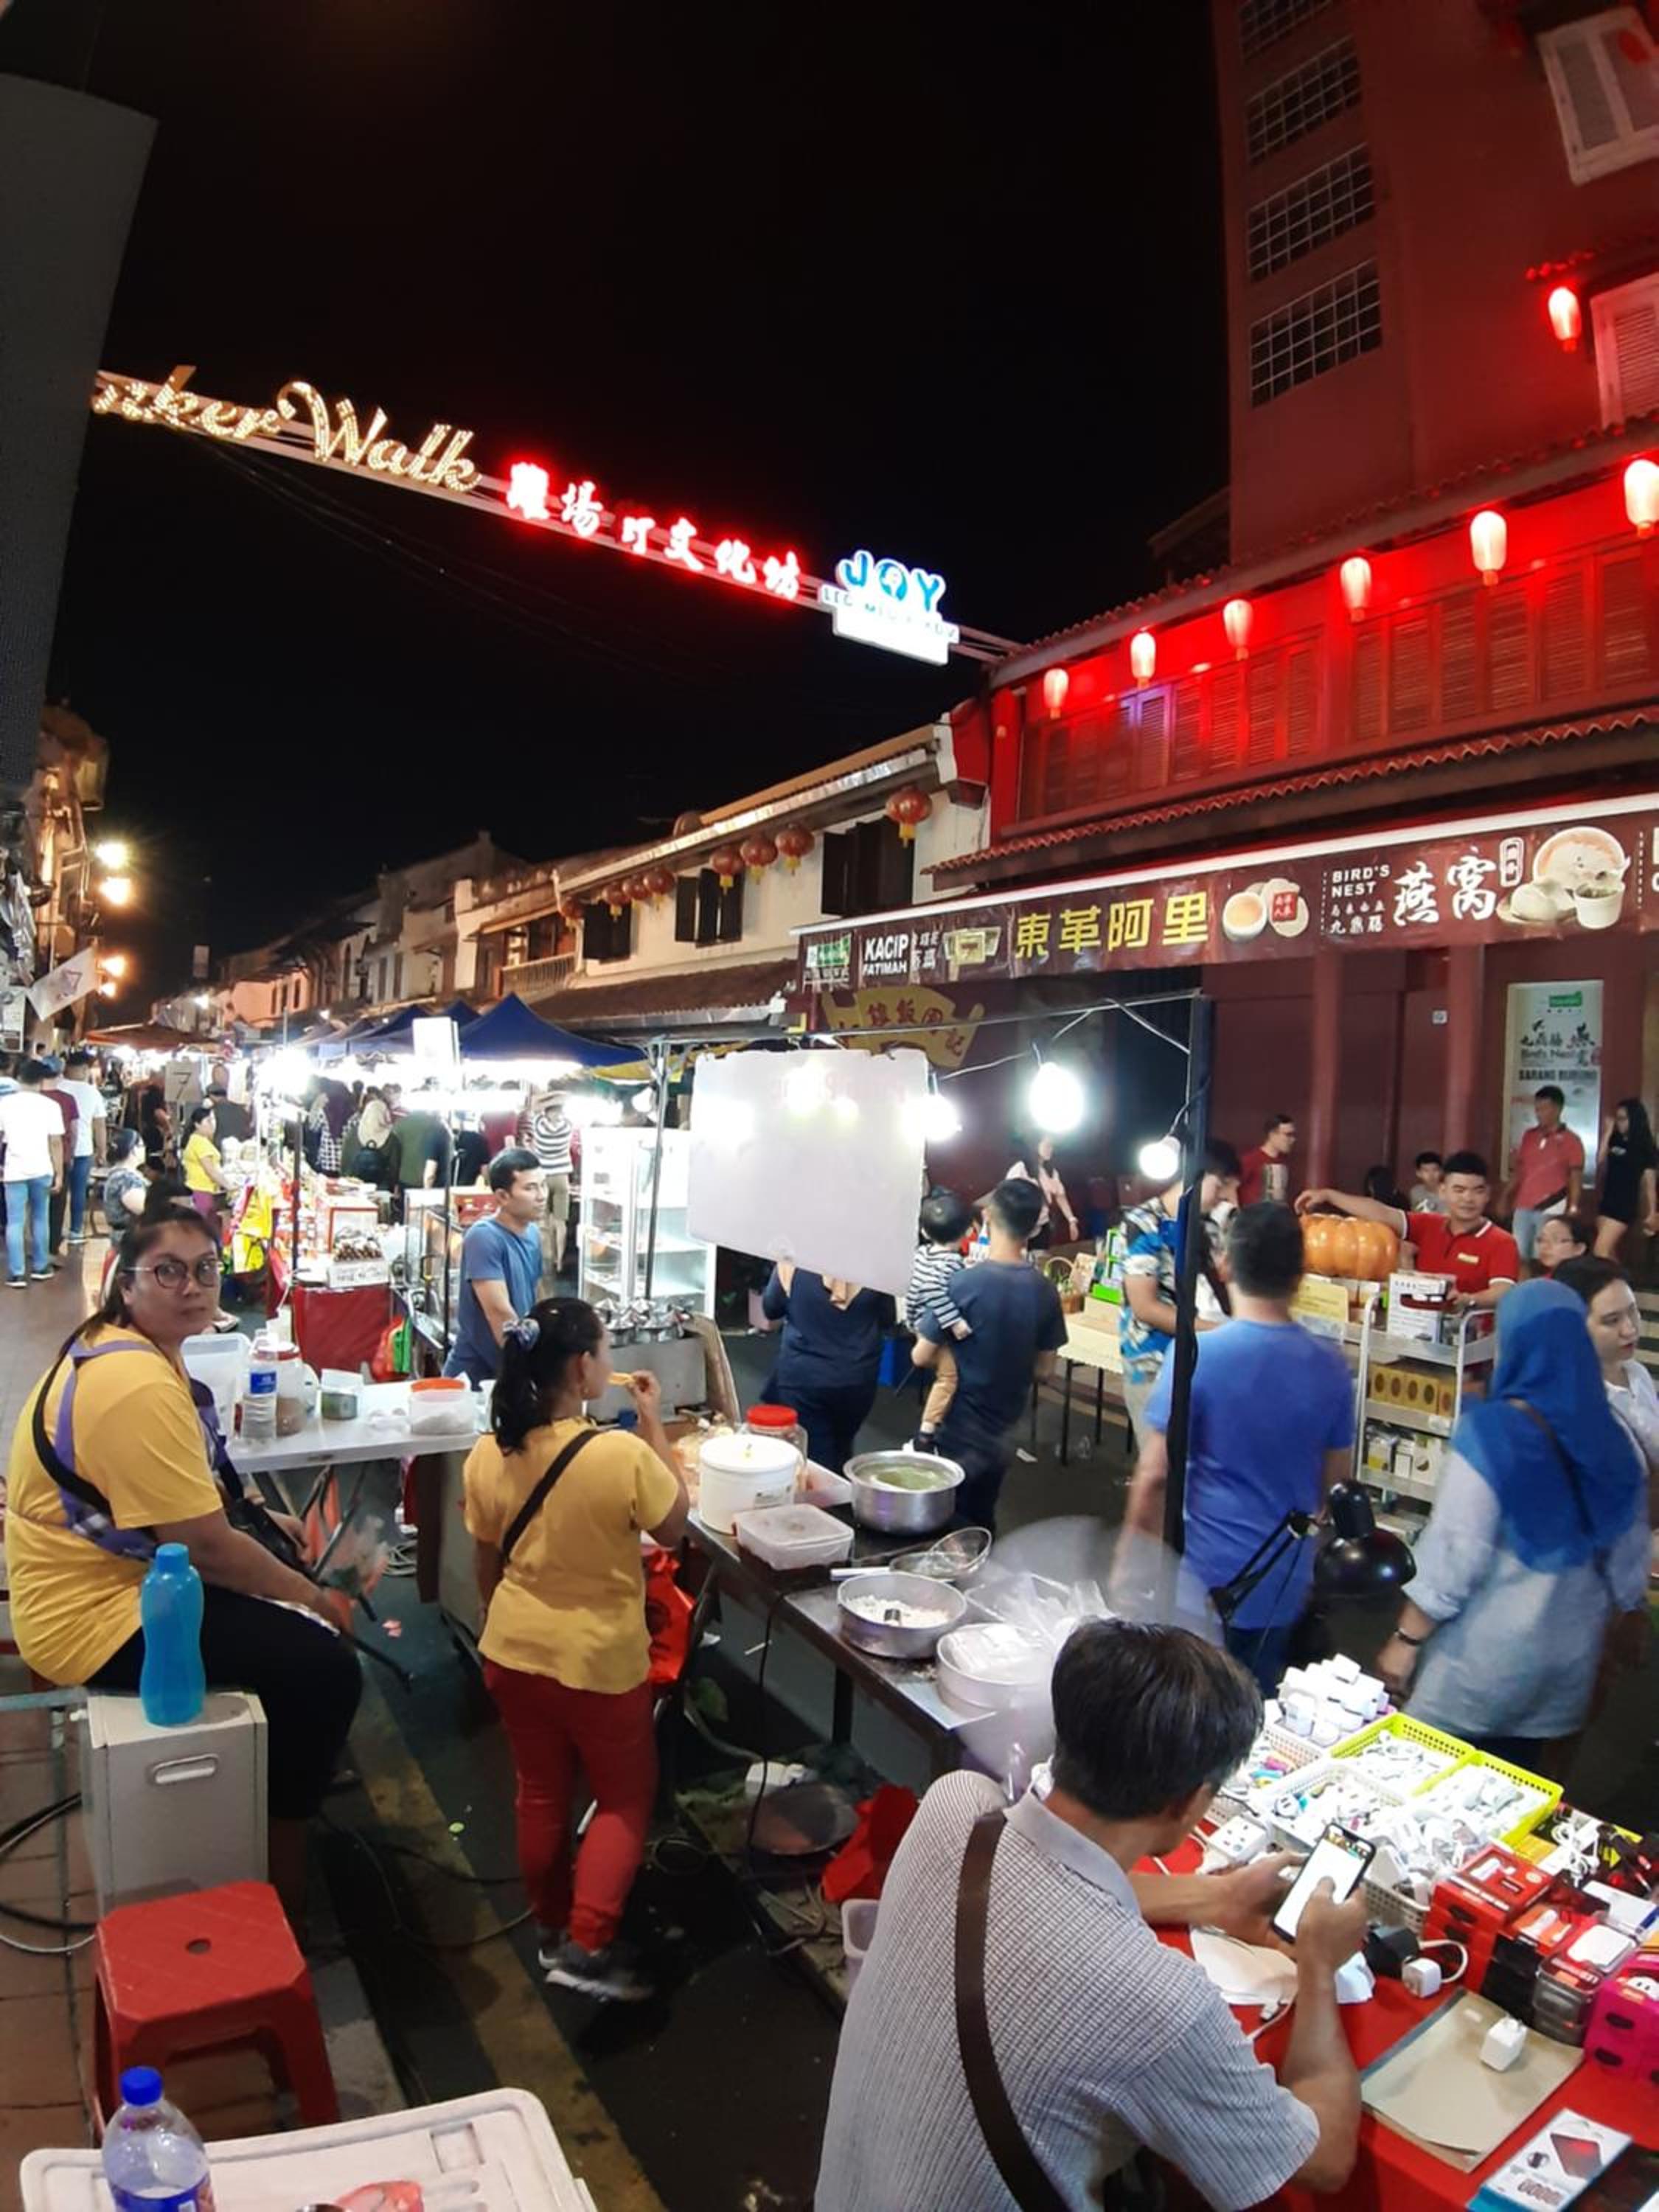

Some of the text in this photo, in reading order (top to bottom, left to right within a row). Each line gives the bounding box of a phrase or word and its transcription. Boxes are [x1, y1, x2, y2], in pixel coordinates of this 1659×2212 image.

[276, 379, 481, 494] Walk
[841, 552, 942, 612] JOY
[1332, 864, 1391, 883] BIRD'S
[1331, 882, 1377, 898] NEST
[1015, 891, 1208, 959] 東革阿里
[865, 934, 908, 961] KACIP
[863, 961, 907, 975] FATIMAH
